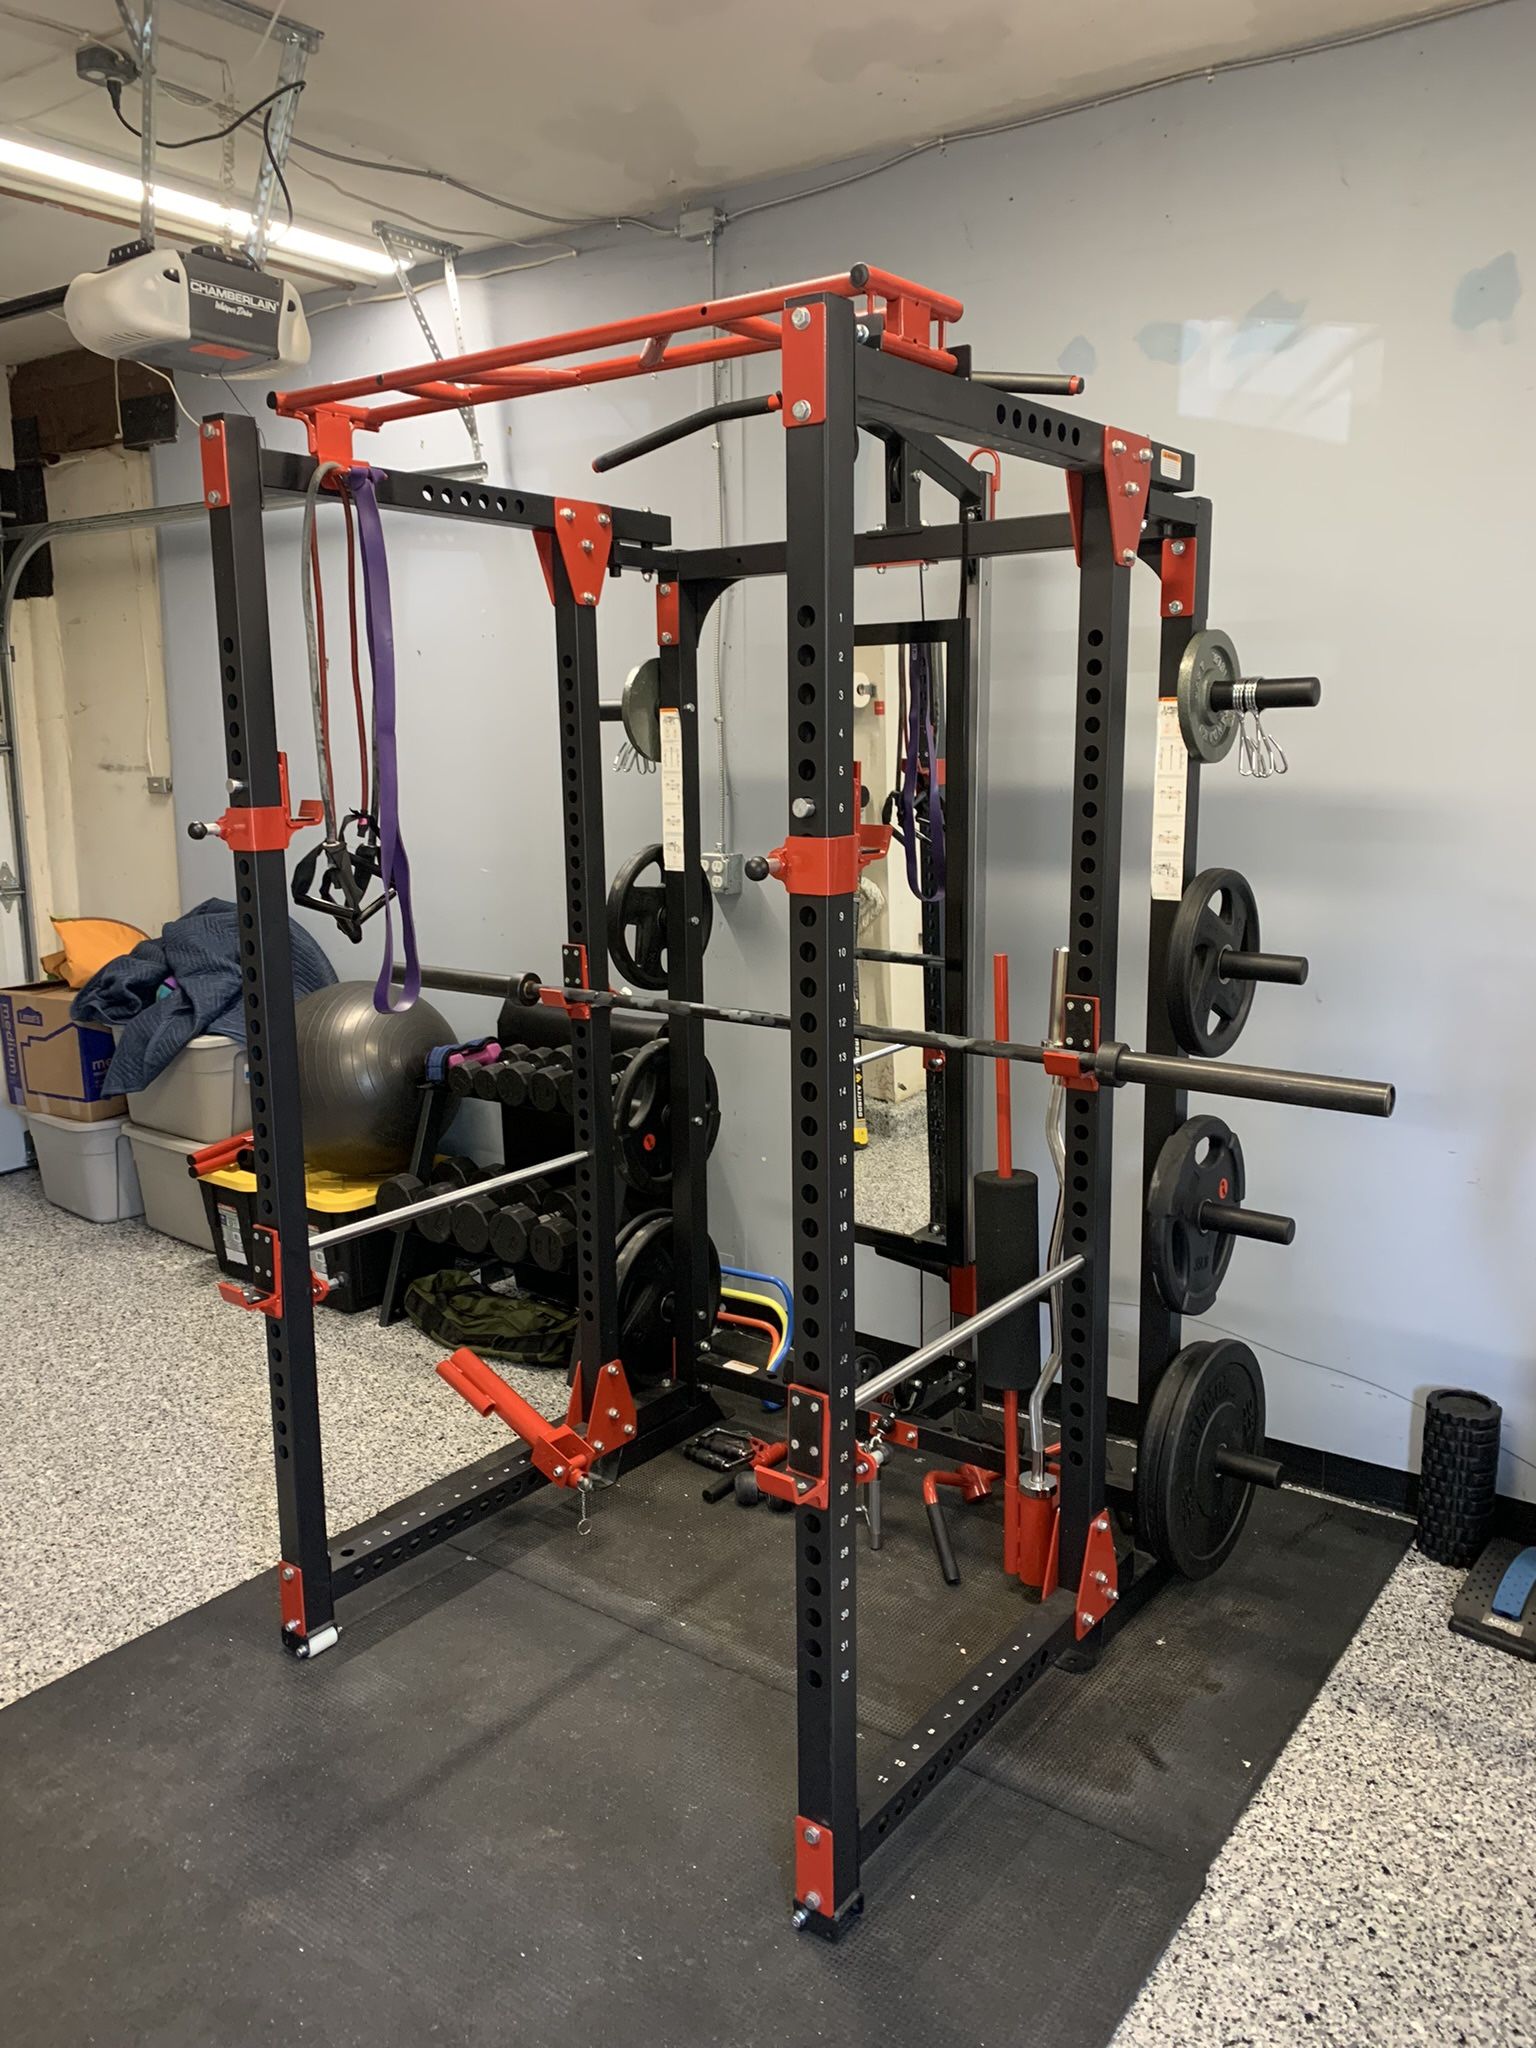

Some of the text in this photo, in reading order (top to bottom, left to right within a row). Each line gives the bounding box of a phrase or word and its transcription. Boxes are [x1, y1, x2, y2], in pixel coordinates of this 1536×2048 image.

[837, 947, 847, 958] 10
[838, 982, 846, 993] 11
[838, 1016, 847, 1028] 12
[838, 1051, 848, 1063] 13
[838, 1086, 847, 1097] 14
[838, 1120, 848, 1131] 15
[839, 1154, 848, 1166] 16
[839, 1187, 848, 1199] 17
[839, 1221, 848, 1233] 18
[839, 1254, 848, 1266] 19
[840, 1639, 849, 1652] 31
